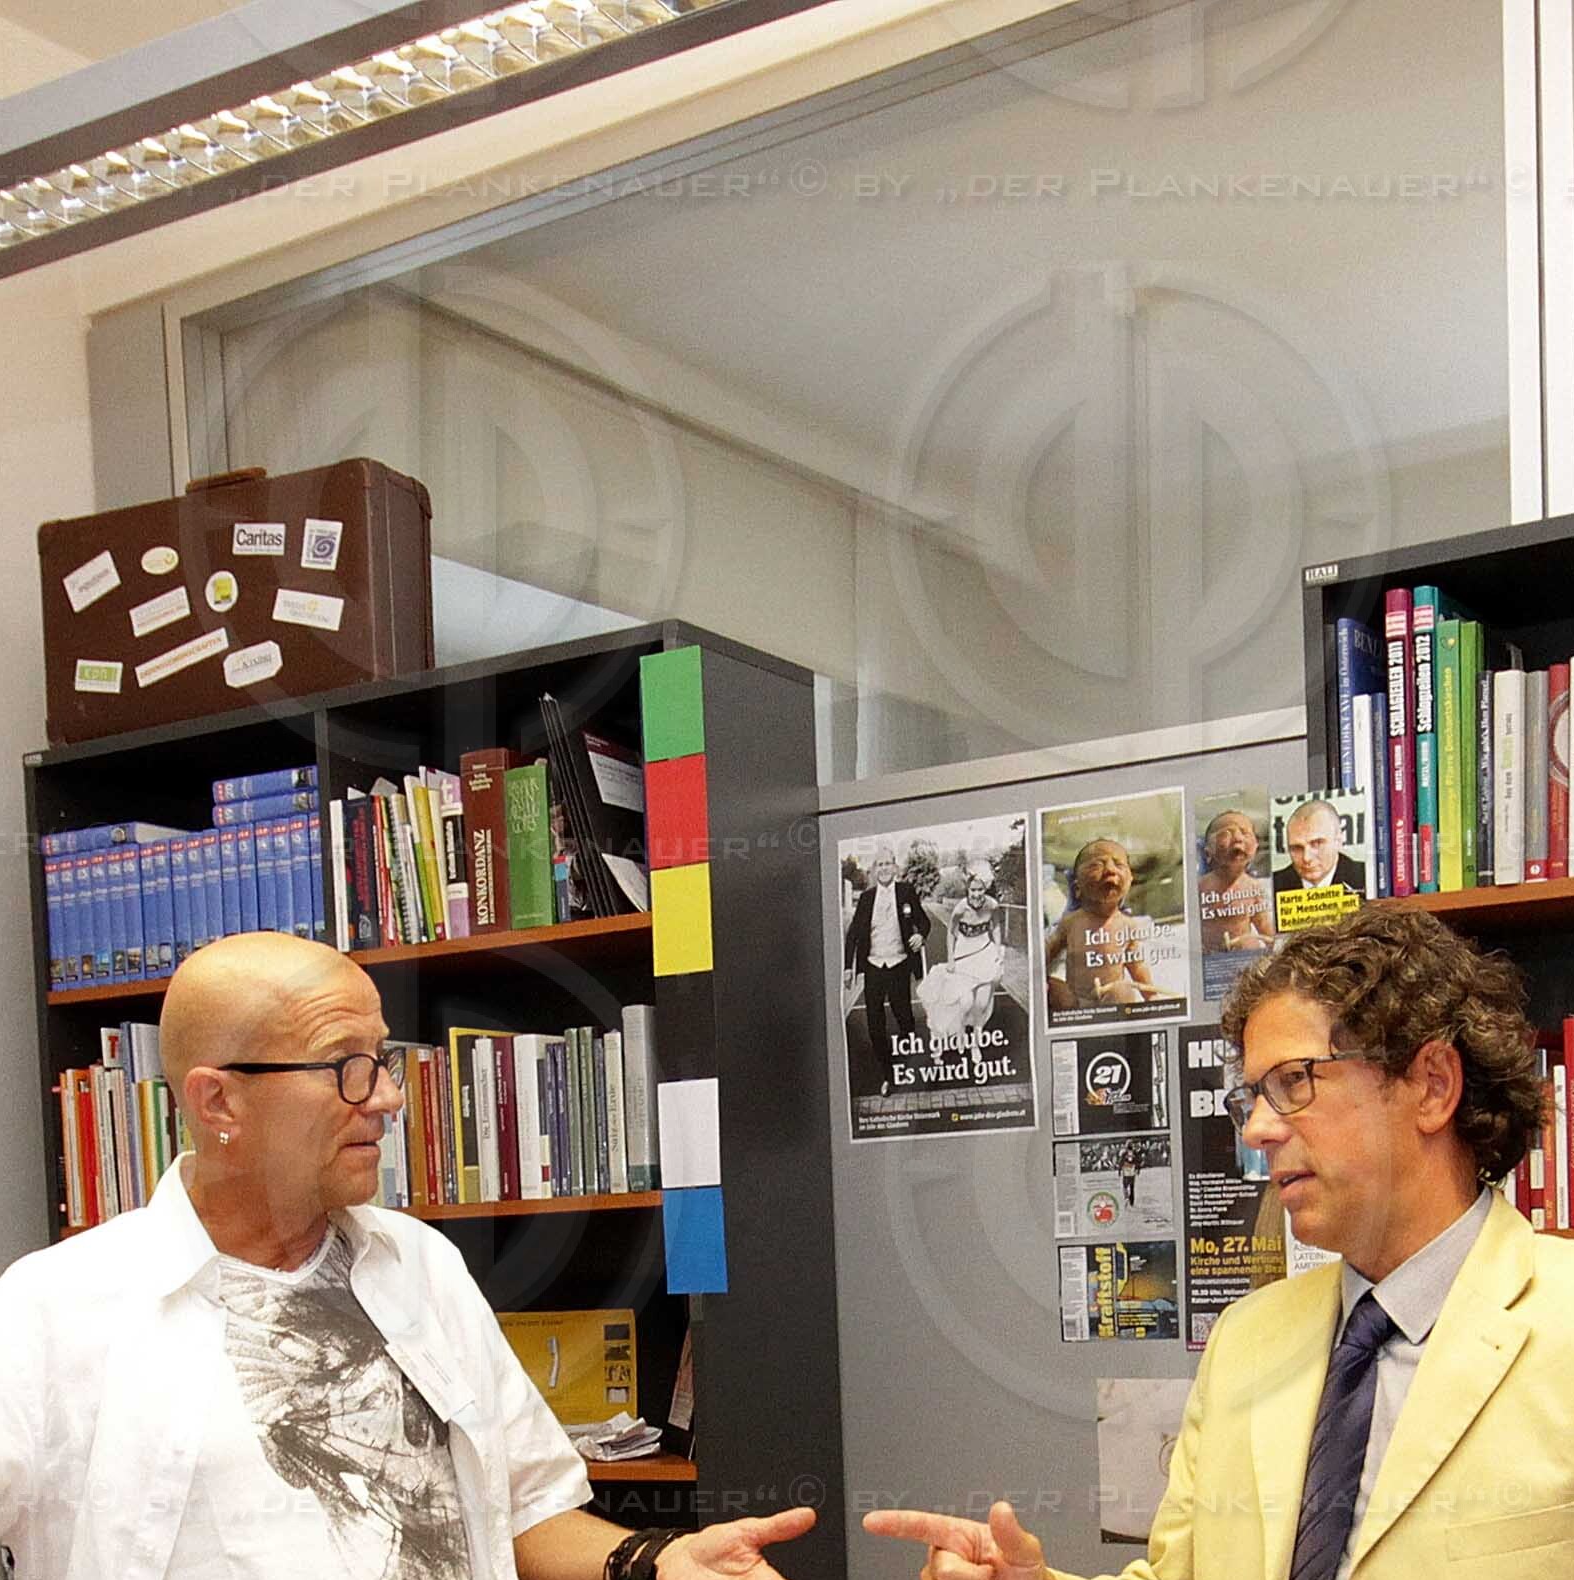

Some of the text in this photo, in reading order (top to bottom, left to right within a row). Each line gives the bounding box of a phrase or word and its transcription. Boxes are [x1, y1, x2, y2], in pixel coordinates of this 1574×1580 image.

[236, 528, 283, 547] Caritas
[1388, 641, 1405, 737] SCHLAGZEILEN 2011
[1416, 634, 1433, 732] Schlagzeilen 2012
[473, 829, 489, 925] KONKORDANZ
[1201, 892, 1220, 905] Ich
[1307, 890, 1340, 902] Schnitte
[1202, 908, 1215, 920] Es
[1216, 905, 1245, 917] wird
[1280, 899, 1357, 915] für Menschen mit
[1085, 924, 1175, 946] Ich glaube.
[1086, 947, 1181, 968] Es wird gut.
[891, 1029, 1009, 1058] Ich glaube.
[892, 1055, 1017, 1085] Es wird gut.
[1093, 1064, 1123, 1084] 21
[1190, 1236, 1282, 1255] Mo, 27. Mai
[1190, 1257, 1220, 1265] Kirche
[1222, 1256, 1240, 1265] und
[1190, 1265, 1262, 1276] eine spannende
[1095, 1247, 1115, 1338] Kraftstoff
